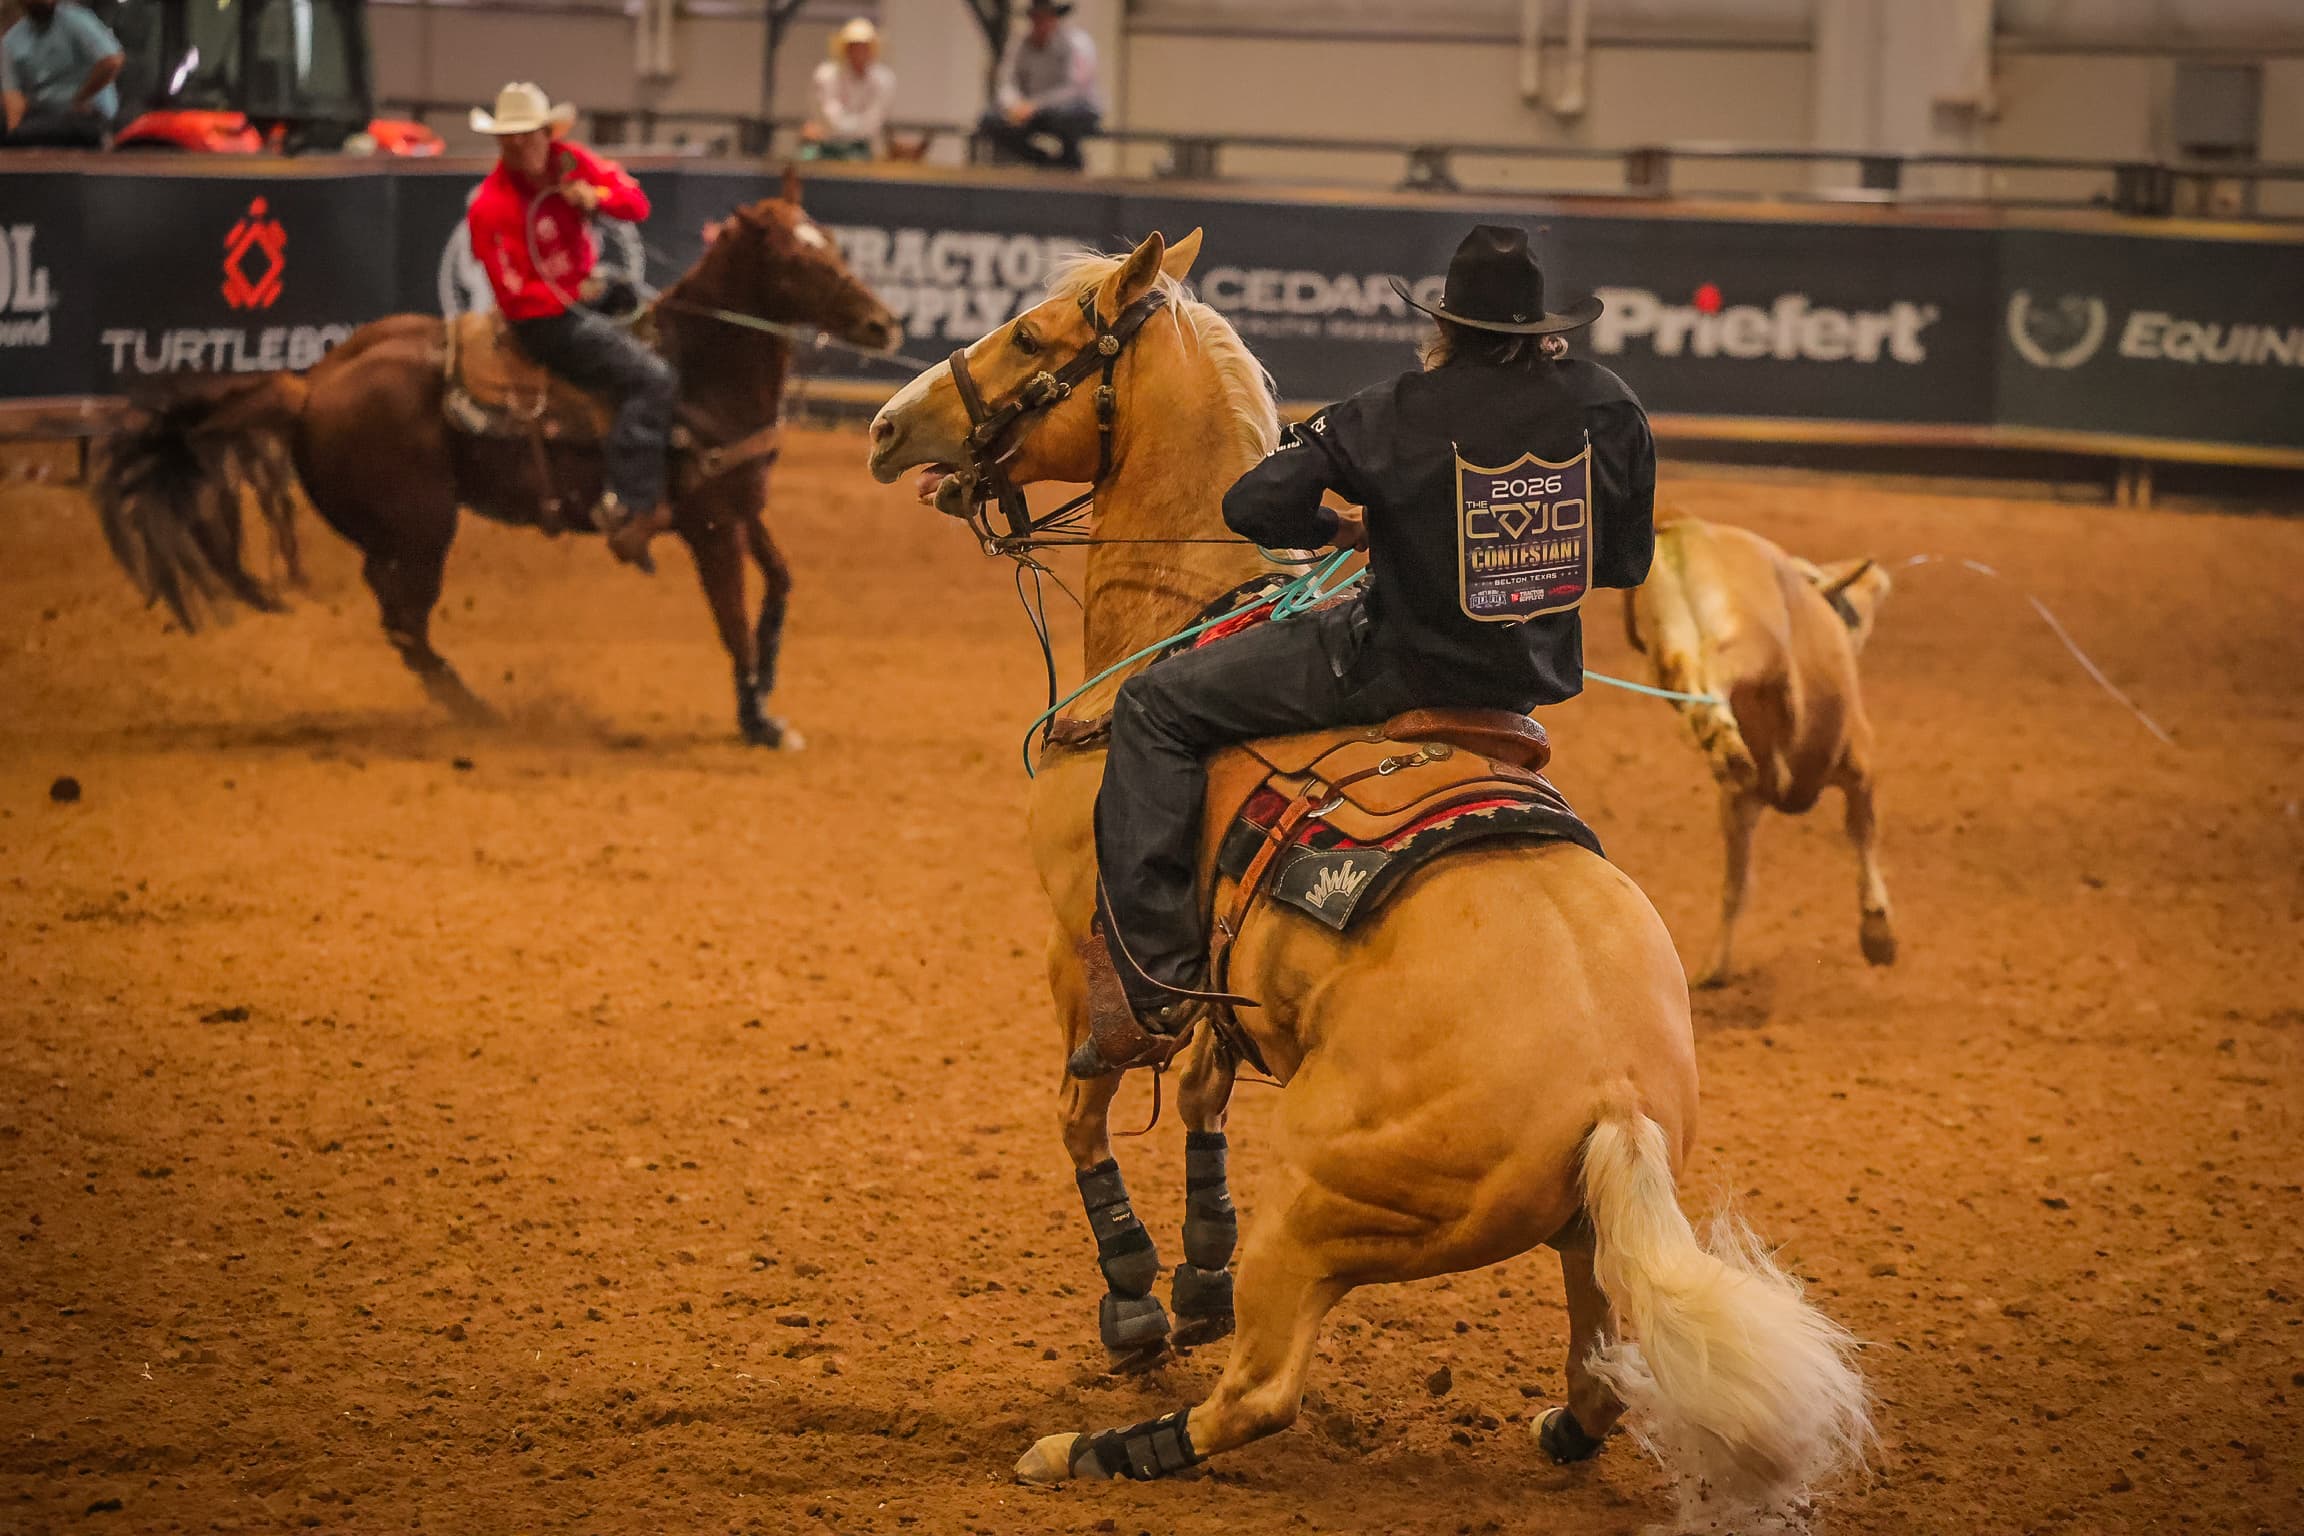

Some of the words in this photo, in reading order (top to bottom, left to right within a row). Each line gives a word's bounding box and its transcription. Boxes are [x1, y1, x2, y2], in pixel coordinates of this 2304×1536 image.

[1592, 283, 1928, 364] Priefert
[2119, 311, 2304, 369] EQUIN
[101, 324, 354, 373] TURTLEBO
[1466, 500, 1488, 509] THE
[1491, 475, 1562, 498] 2026
[1471, 536, 1581, 573] CONTESTANT
[1495, 577, 1527, 586] BELTON
[1530, 572, 1557, 581] TEXAS
